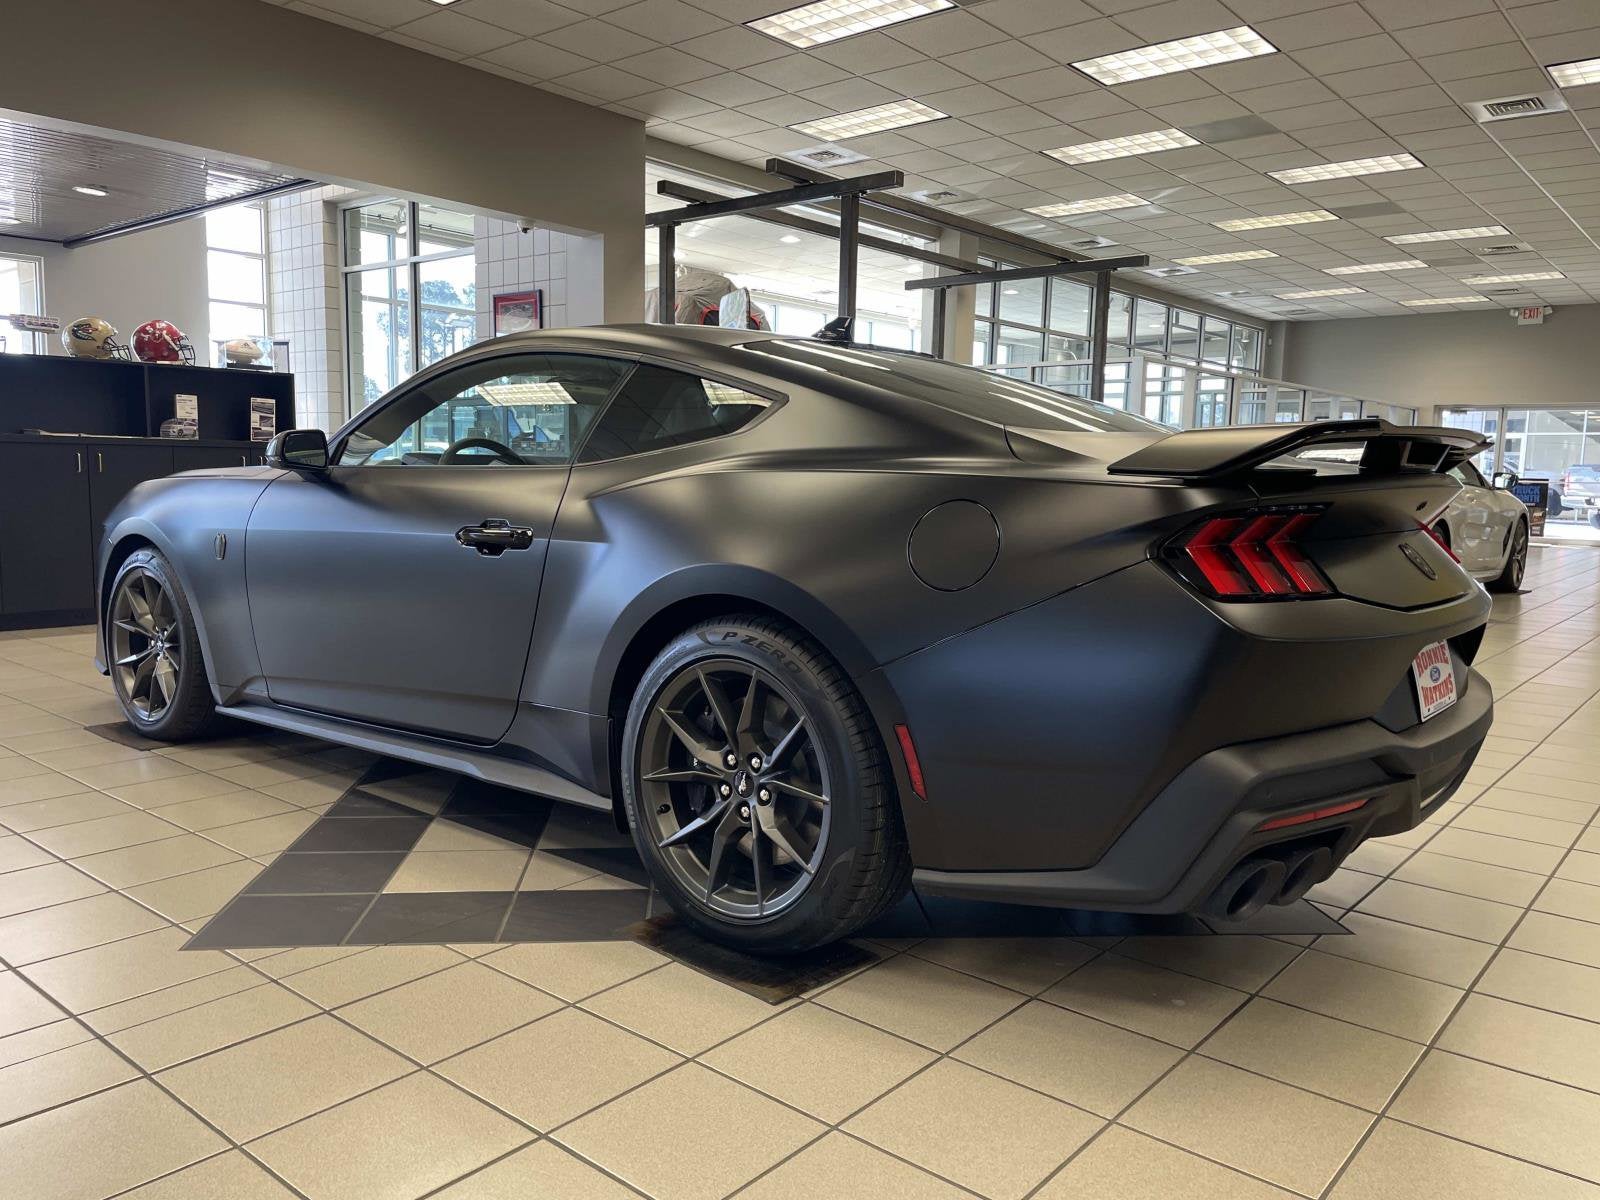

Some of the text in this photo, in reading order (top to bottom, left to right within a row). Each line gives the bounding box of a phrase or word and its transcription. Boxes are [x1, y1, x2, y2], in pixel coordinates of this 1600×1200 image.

[1523, 308, 1539, 320] EXIT
[1518, 494, 1540, 503] ONTH
[721, 631, 802, 673] P ZERO
[1415, 644, 1449, 677] RONNIE
[1421, 673, 1454, 708] WATKINS
